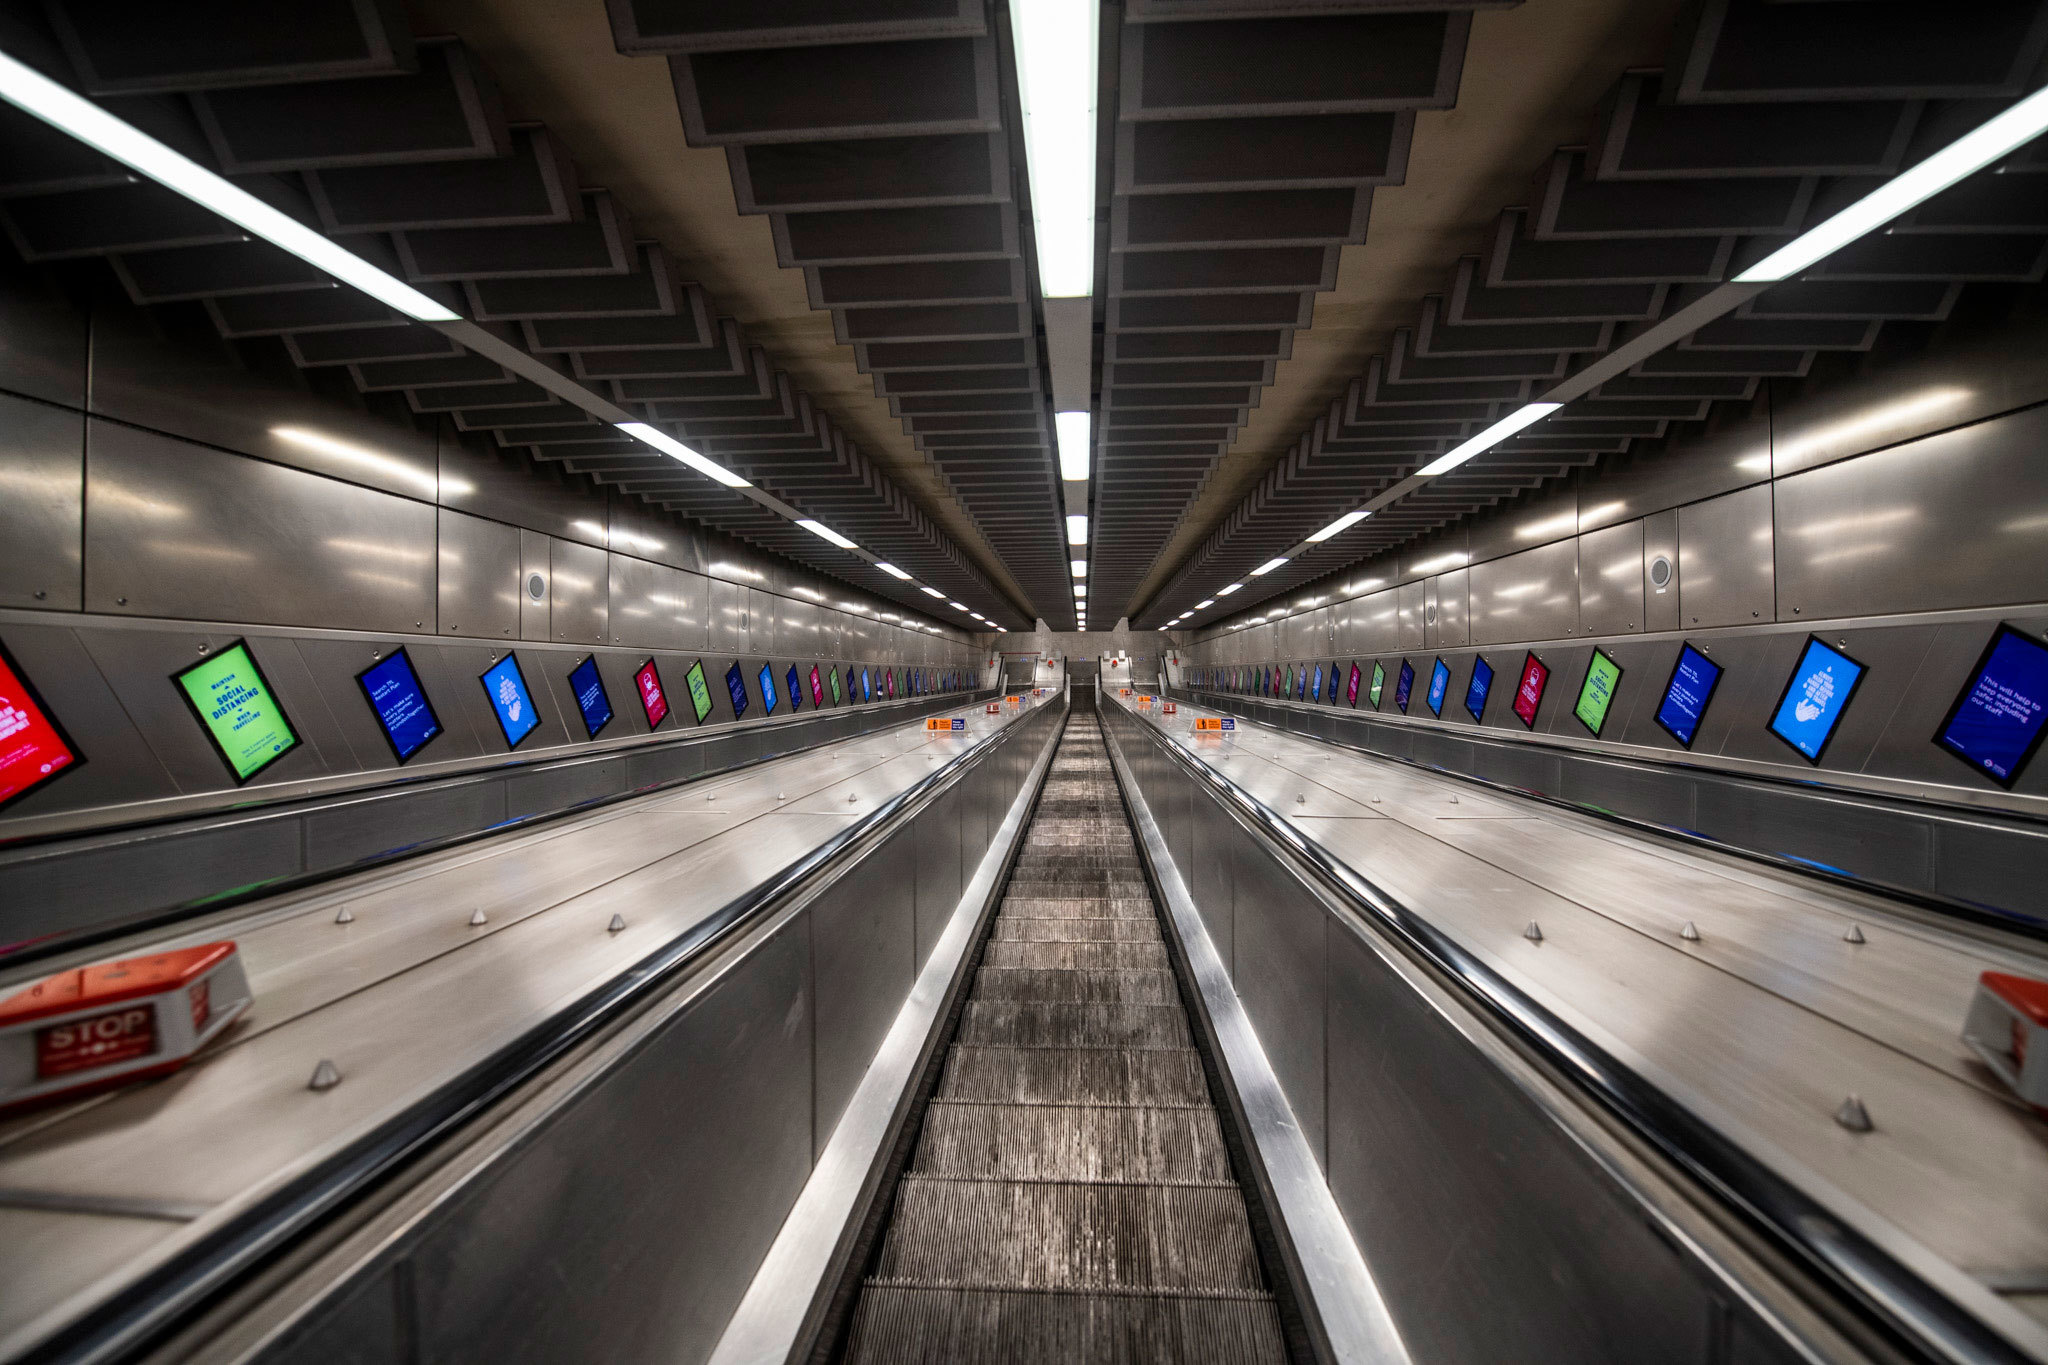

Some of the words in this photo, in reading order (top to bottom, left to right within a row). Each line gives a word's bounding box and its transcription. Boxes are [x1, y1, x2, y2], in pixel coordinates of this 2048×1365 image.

[1818, 670, 1834, 684] ALWAYS
[216, 685, 246, 706] SOCIAL
[372, 684, 388, 696] Search
[1979, 682, 1996, 696] keep
[1996, 693, 2031, 715] everyone
[1984, 675, 1999, 688] This
[1999, 685, 2014, 697] will
[2013, 692, 2031, 706] help
[2031, 702, 2041, 711] to
[212, 687, 260, 720] DISTANCING
[385, 712, 398, 722] every
[397, 700, 413, 714] journey
[393, 699, 405, 709] make
[404, 693, 414, 701] sure
[1971, 696, 1985, 706] our
[1984, 703, 2003, 717] staff
[388, 713, 405, 727] matters
[1994, 700, 2029, 724] including
[49, 1010, 147, 1049] STOP
